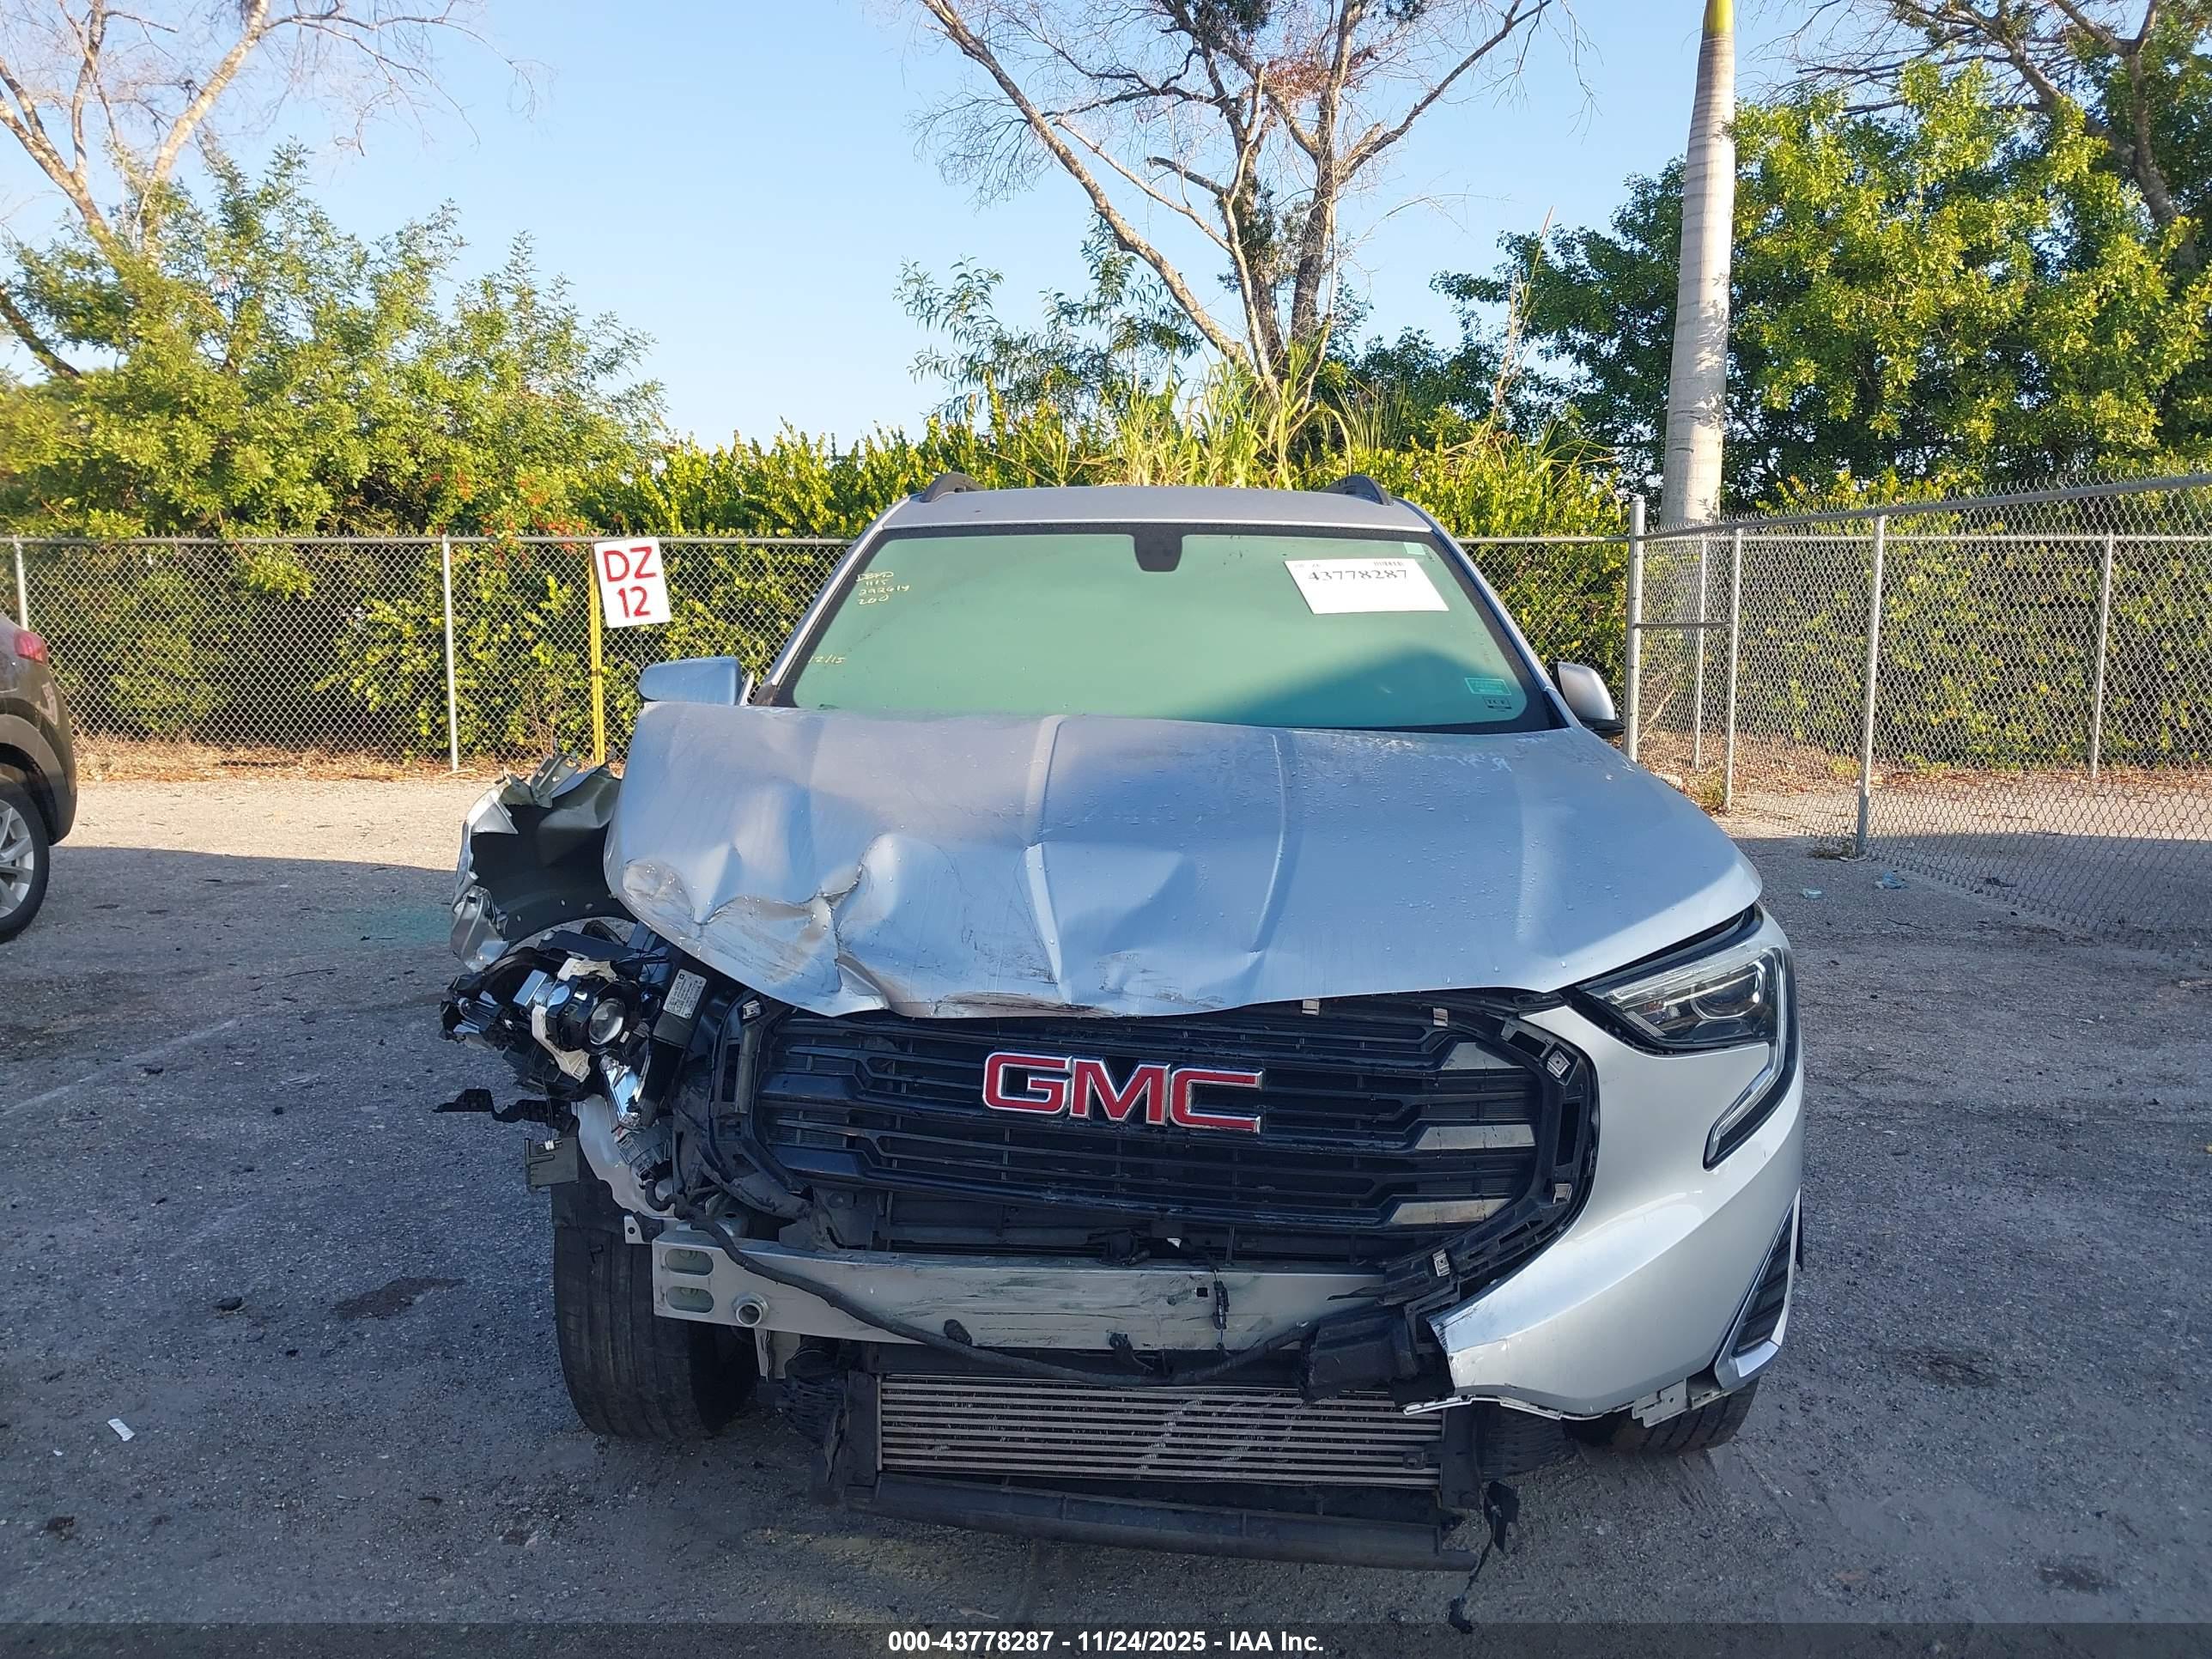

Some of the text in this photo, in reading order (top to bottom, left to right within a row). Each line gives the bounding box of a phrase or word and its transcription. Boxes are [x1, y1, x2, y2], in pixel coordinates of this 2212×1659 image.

[603, 546, 658, 582] DZ
[1309, 568, 1407, 581] 43778287
[617, 586, 652, 619] 12
[982, 1050, 1264, 1134] GMC
